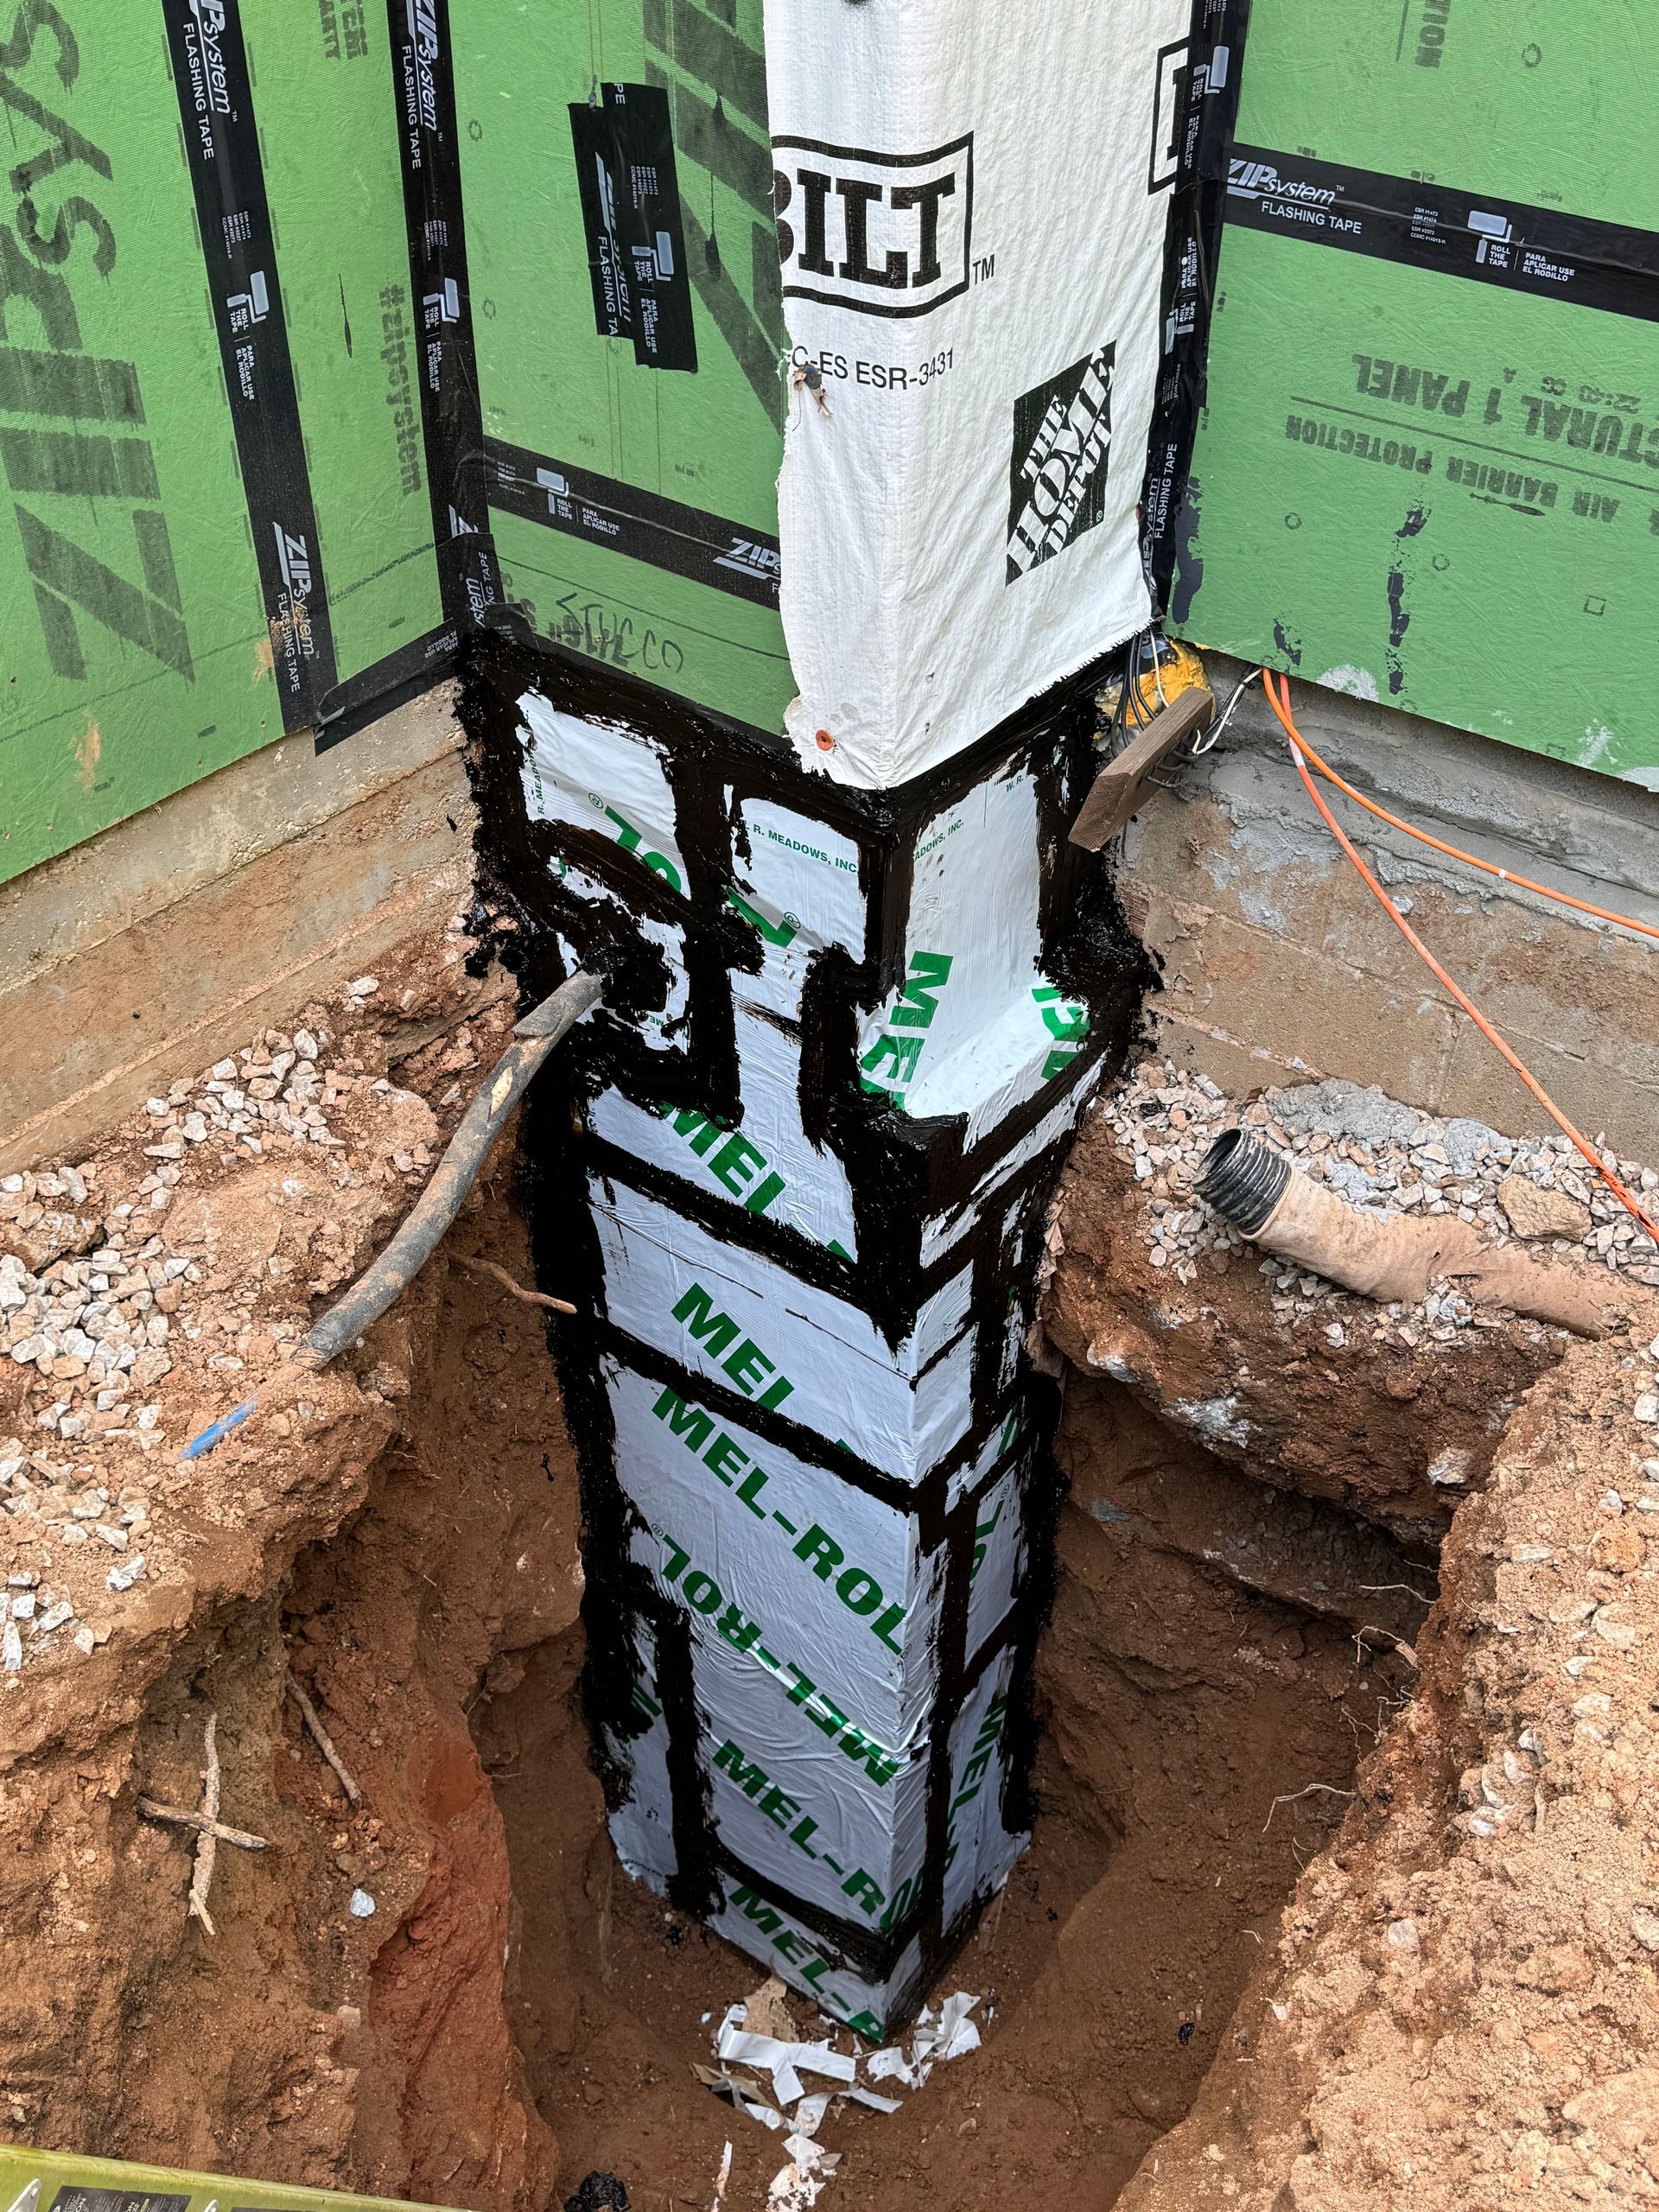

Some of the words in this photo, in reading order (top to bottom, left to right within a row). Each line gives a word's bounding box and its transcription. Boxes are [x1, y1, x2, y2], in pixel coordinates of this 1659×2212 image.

[183, 22, 207, 111] FLASHING
[198, 115, 214, 160] TAPE
[402, 45, 417, 125] FLASHING
[410, 128, 422, 169] TAPE
[1262, 200, 1325, 226] FLASHING
[1329, 216, 1363, 234] TAPE
[634, 260, 643, 282] TAPE
[1489, 257, 1508, 268] TAPE
[1490, 251, 1505, 261] THE
[1491, 245, 1510, 255] ROLL
[1523, 259, 1557, 271] APLICAR
[1559, 267, 1575, 276] USE
[1525, 252, 1546, 263] PARA
[598, 235, 615, 315] FLASHING
[1534, 270, 1568, 282] RODILLO
[643, 311, 652, 347] RODILLO
[645, 298, 654, 334] APLICAR
[236, 349, 240, 360] EL
[238, 361, 248, 397] RODILLO
[241, 347, 251, 382] APLICAR
[246, 345, 255, 367] PARA
[855, 347, 954, 390] ESR-3431
[1351, 353, 1471, 417] PANEL
[1007, 347, 1116, 573] HOME
[1020, 395, 1067, 483] THE
[1285, 415, 1433, 475] PROTECTION
[1046, 412, 1112, 553] DEPOT
[1154, 478, 1171, 539] FLASHING
[1164, 443, 1177, 475] TAPE
[1446, 456, 1559, 508] BARRIER
[1573, 490, 1621, 524] AIR
[479, 552, 491, 582] TAPE
[277, 593, 295, 658] FLASHING
[288, 660, 300, 692] TAPE
[753, 823, 765, 836] R.
[768, 830, 830, 865] MEADOWS,
[912, 833, 945, 862] ADOWS,
[948, 819, 964, 836] INC.
[651, 1387, 907, 1656] MEL-ROL
